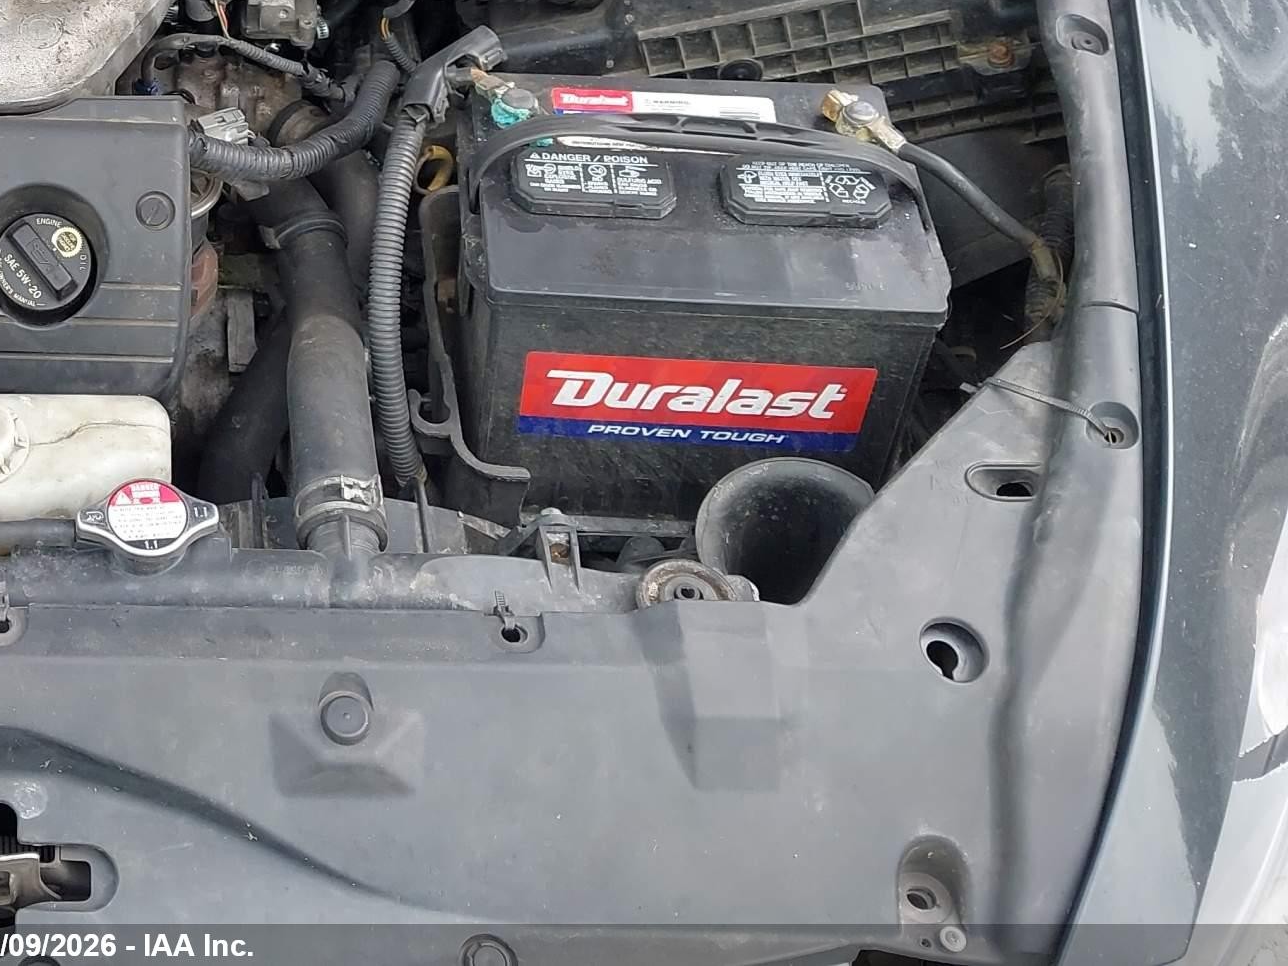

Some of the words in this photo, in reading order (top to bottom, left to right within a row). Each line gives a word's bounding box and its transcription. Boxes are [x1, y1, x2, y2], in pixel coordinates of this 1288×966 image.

[542, 153, 591, 162] DANGER
[603, 155, 649, 164] POISON
[36, 218, 62, 227] ENGINE
[4, 253, 20, 271] SAE
[16, 269, 42, 299] 5W-20
[13, 293, 36, 307] MANUAL
[546, 369, 848, 420] Duralast
[587, 424, 693, 439] PROVEN
[701, 430, 785, 445] TOUGH
[193, 506, 209, 518] 1.1
[144, 540, 158, 549] 1.1
